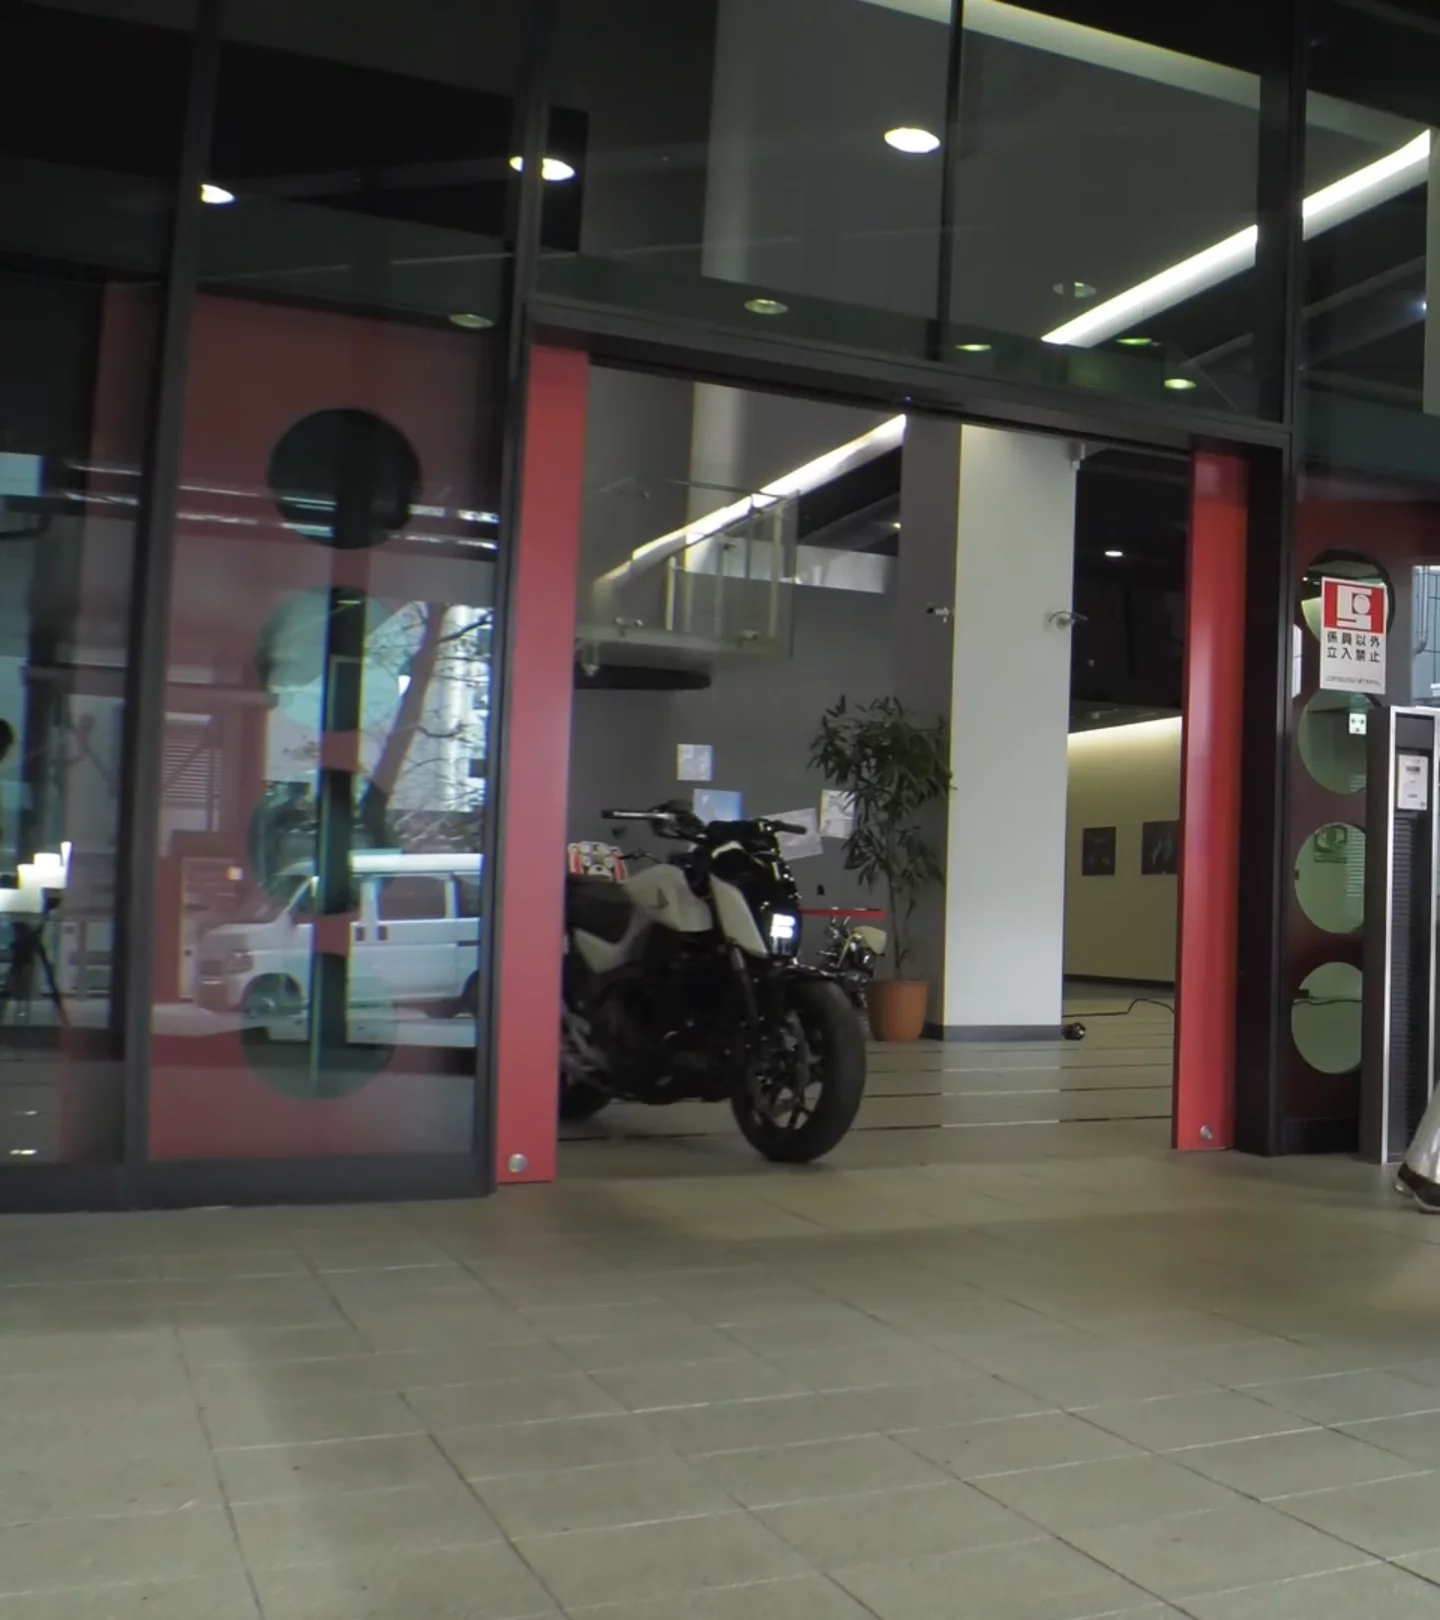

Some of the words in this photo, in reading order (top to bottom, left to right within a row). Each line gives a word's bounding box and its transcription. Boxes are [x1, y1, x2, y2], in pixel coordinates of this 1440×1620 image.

[1327, 631, 1381, 648] 係員以外
[1327, 646, 1381, 663] 立入禁止
